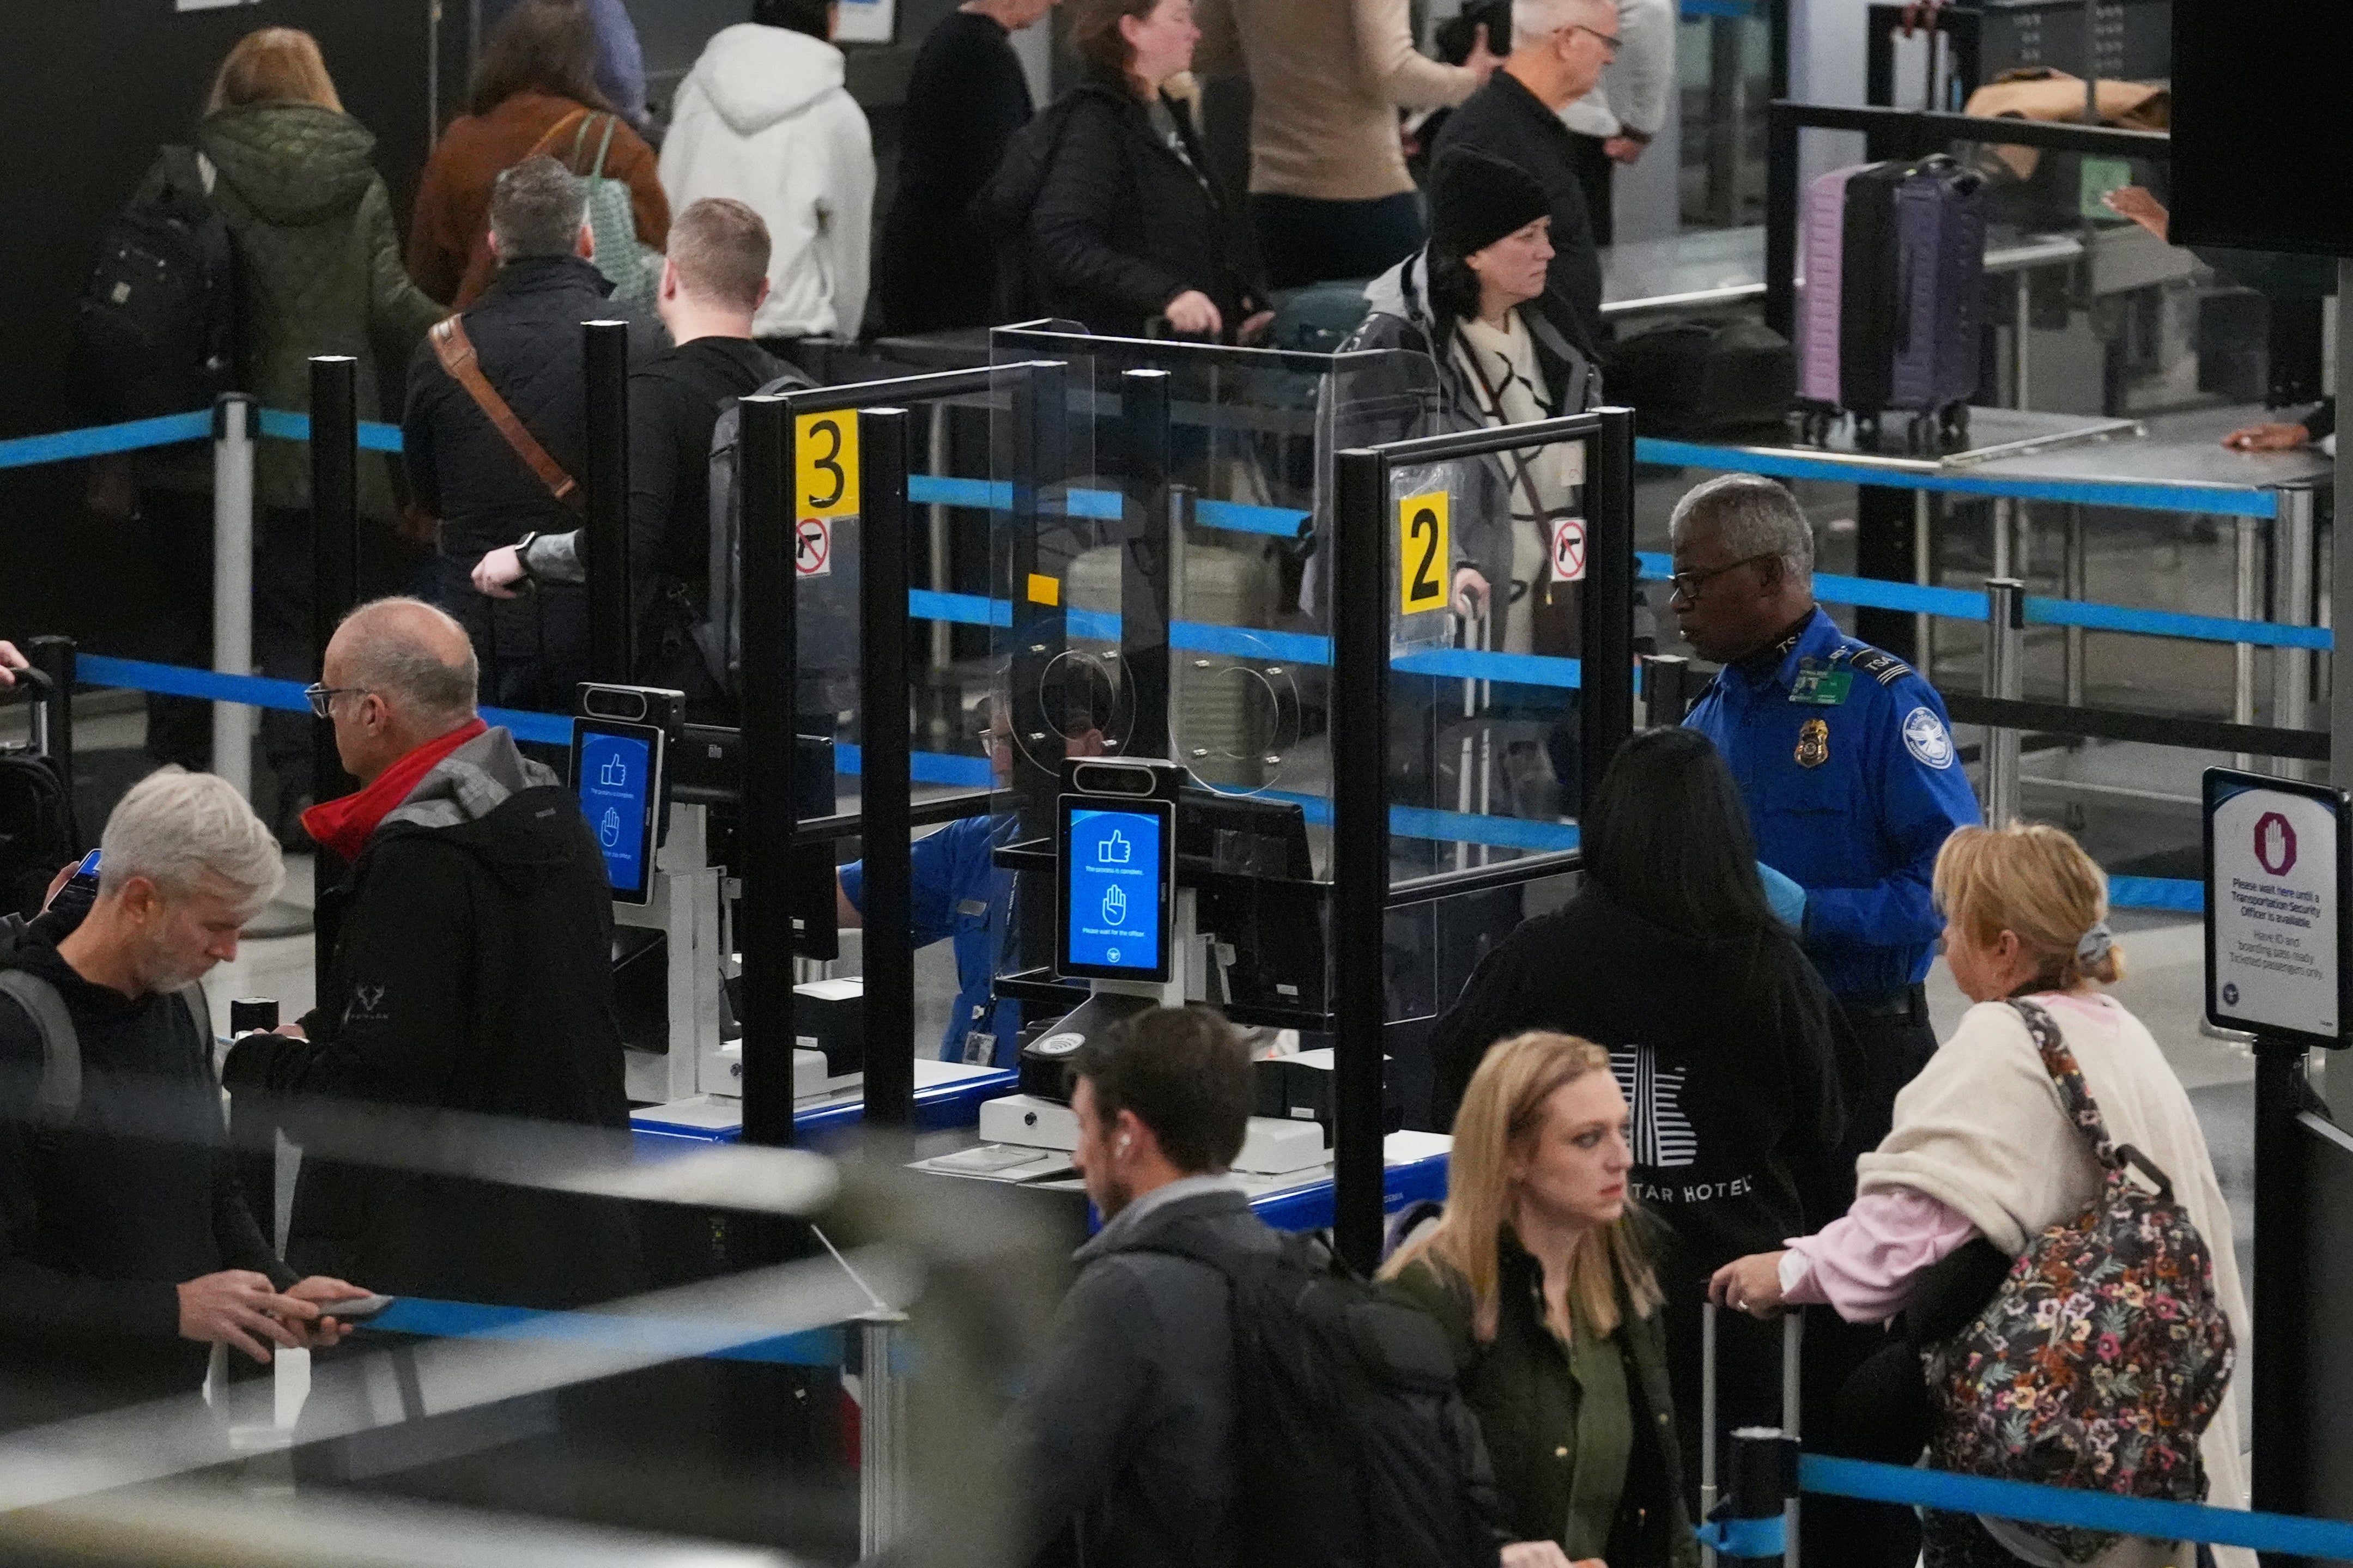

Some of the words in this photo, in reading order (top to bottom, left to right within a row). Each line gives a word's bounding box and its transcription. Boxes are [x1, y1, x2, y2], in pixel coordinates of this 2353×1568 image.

[809, 420, 844, 508] 3
[1411, 508, 1439, 601] 2
[1776, 633, 1802, 654] TS
[1864, 655, 1895, 671] TSA
[2233, 878, 2257, 891] Please
[2259, 884, 2276, 895] wait
[2277, 885, 2295, 898] here
[2231, 891, 2289, 910] Transportation
[2289, 902, 2321, 918] Security
[2241, 905, 2267, 920] Officer
[2268, 913, 2275, 922] is
[1632, 1183, 1673, 1202] TAR
[1683, 1176, 1751, 1202] HOTEL
